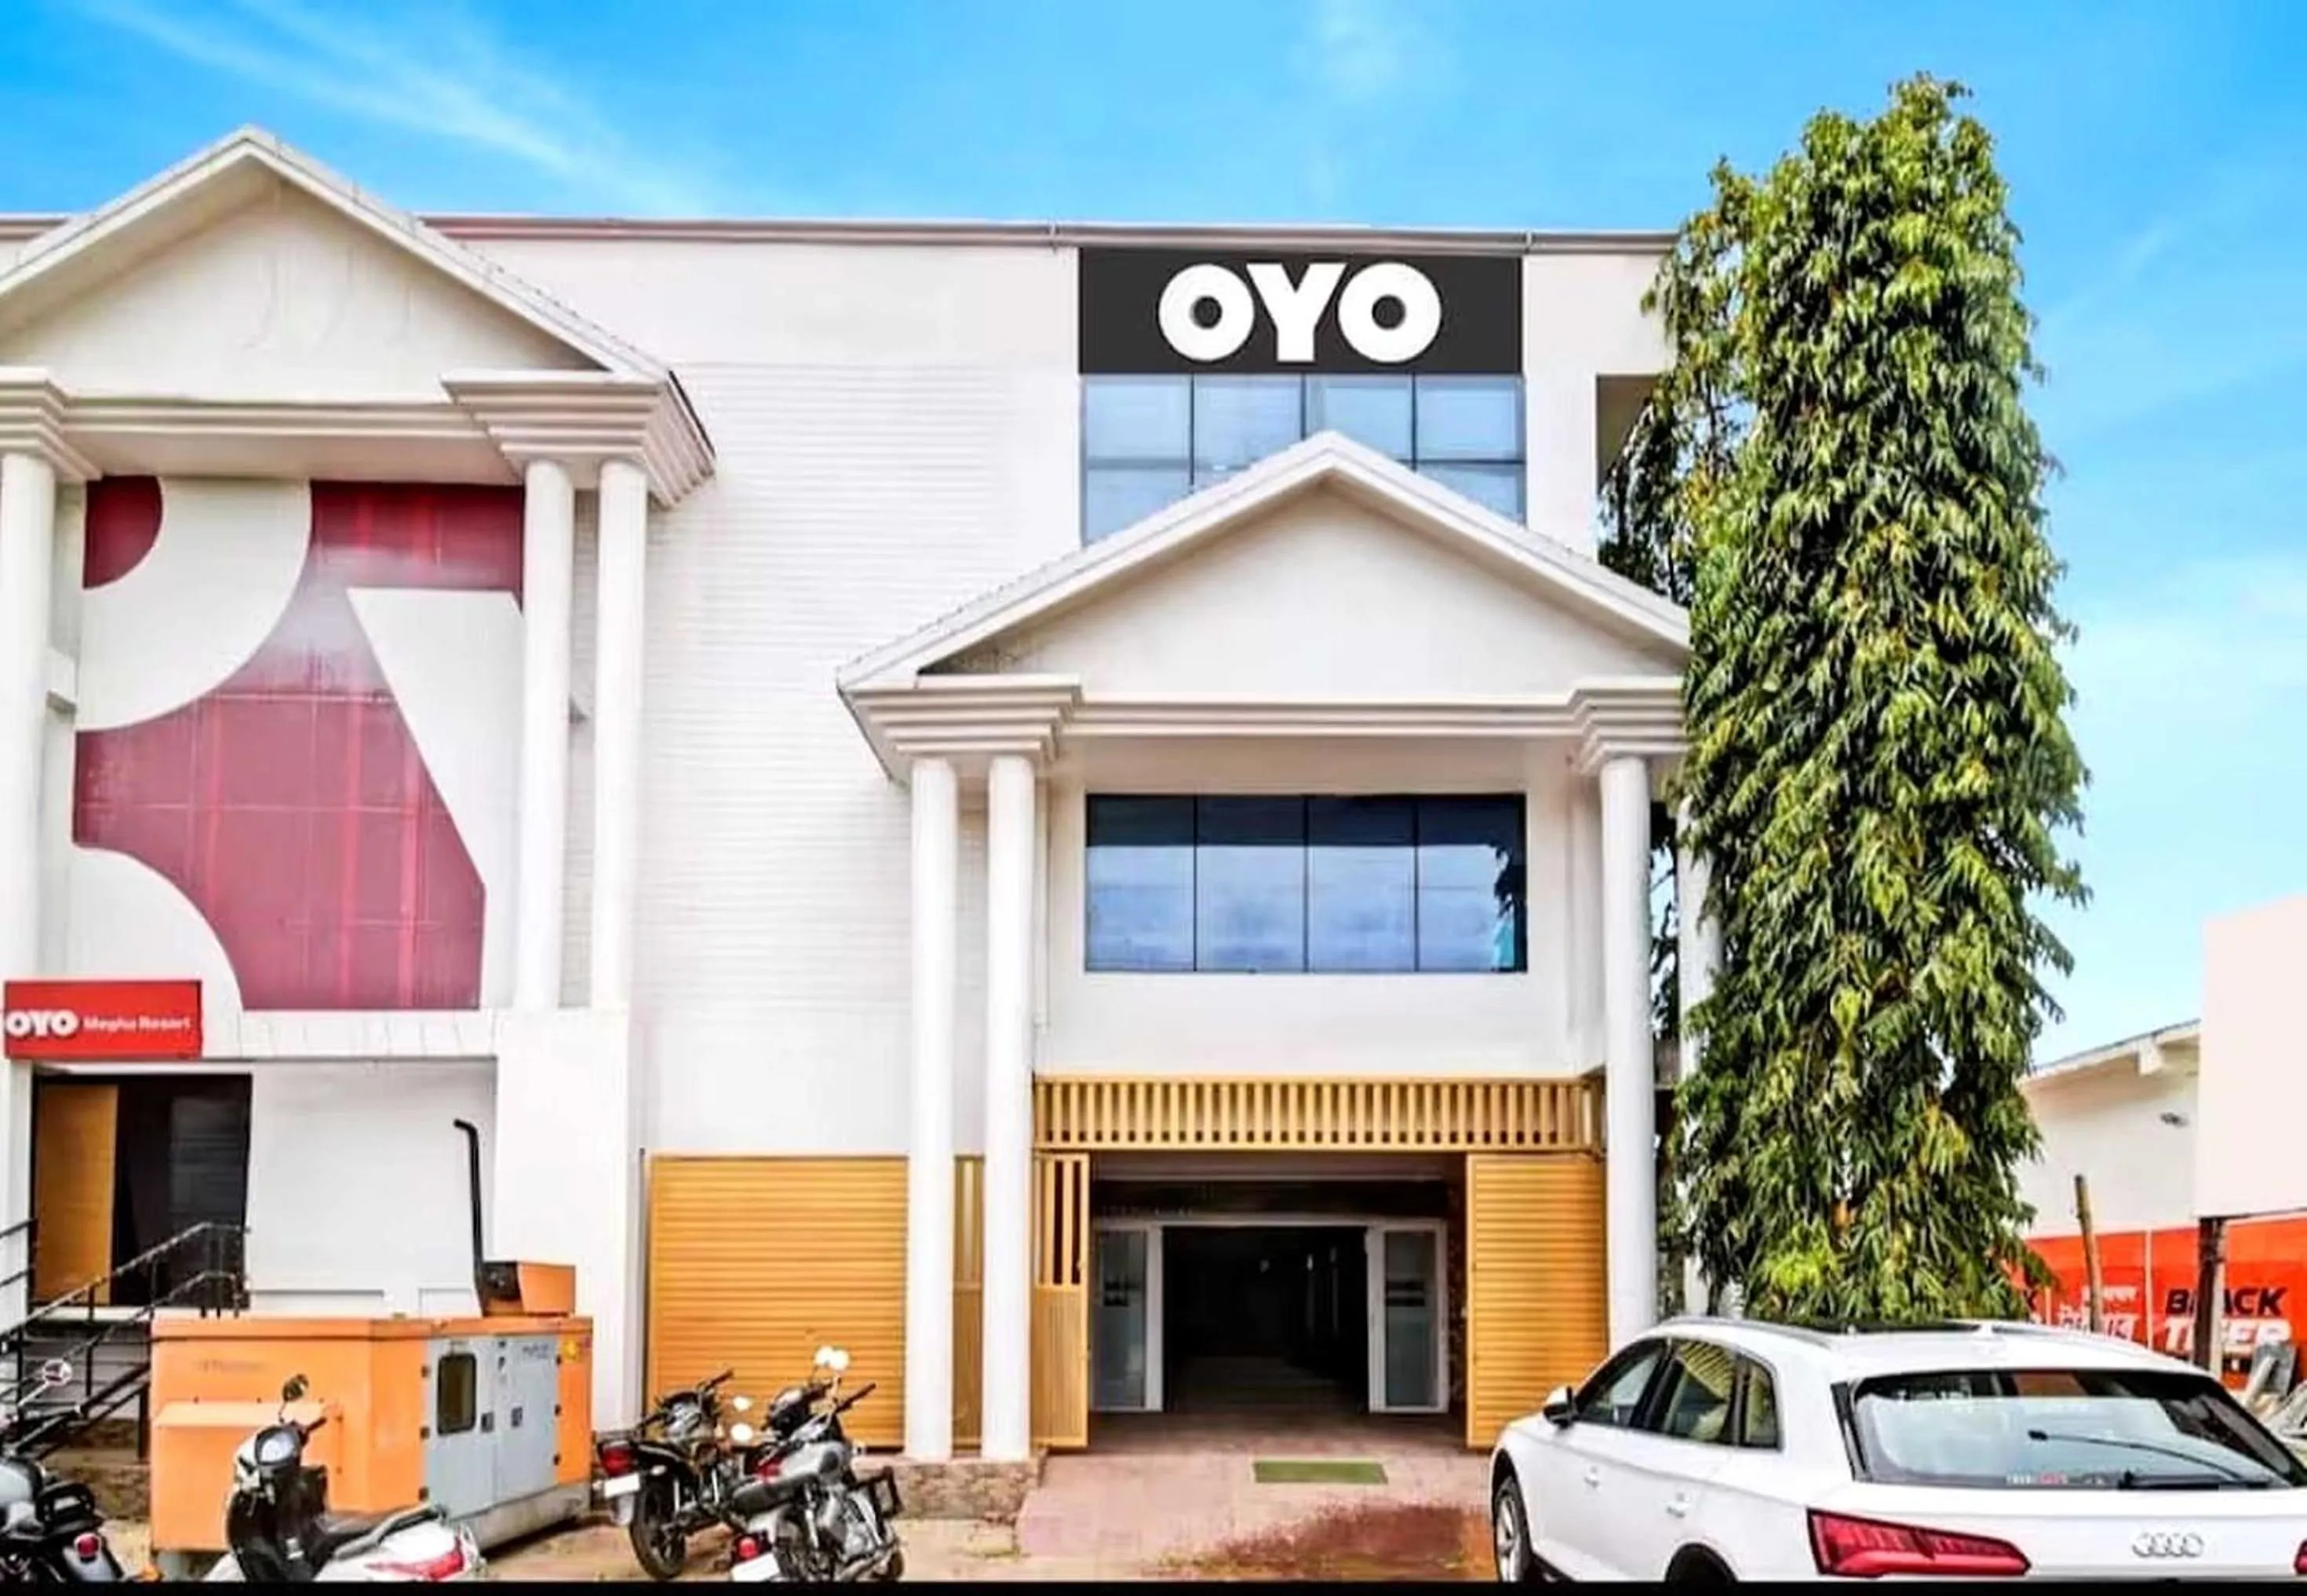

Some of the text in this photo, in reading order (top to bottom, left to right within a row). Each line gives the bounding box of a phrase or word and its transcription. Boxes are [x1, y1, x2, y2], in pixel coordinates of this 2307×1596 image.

[1157, 262, 1441, 363] OYO
[5, 1009, 78, 1037] OYO
[2166, 1287, 2287, 1316] BCK
